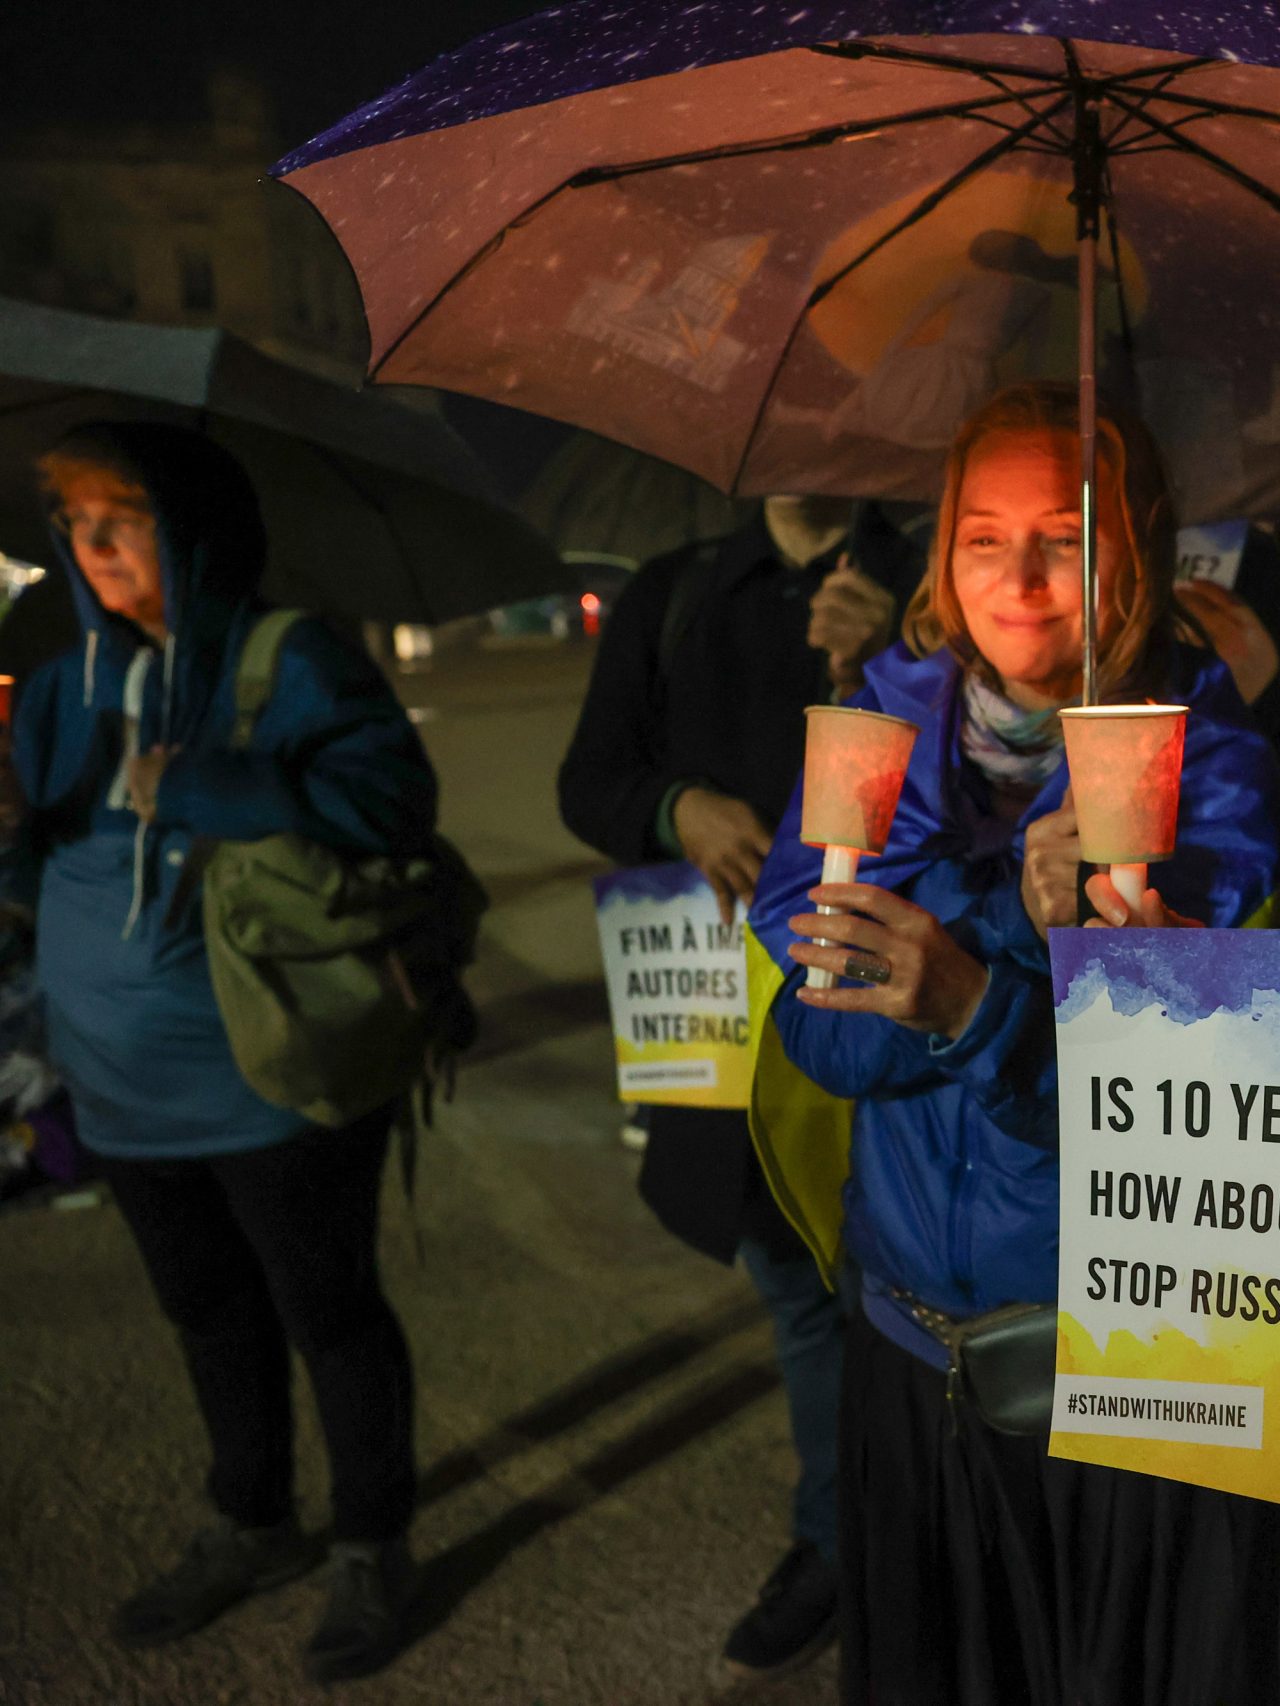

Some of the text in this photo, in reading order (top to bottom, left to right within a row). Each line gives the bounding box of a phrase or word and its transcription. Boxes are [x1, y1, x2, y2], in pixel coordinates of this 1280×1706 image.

[619, 923, 672, 955] FIM
[682, 914, 699, 951] À
[626, 968, 738, 1000] AUTORES
[1090, 1076, 1135, 1133] IS
[1156, 1079, 1211, 1138] 10
[1090, 1169, 1182, 1224] HOW
[1086, 1256, 1178, 1309] STOP
[1067, 1393, 1247, 1429] #STANDWITHUKRAINE
